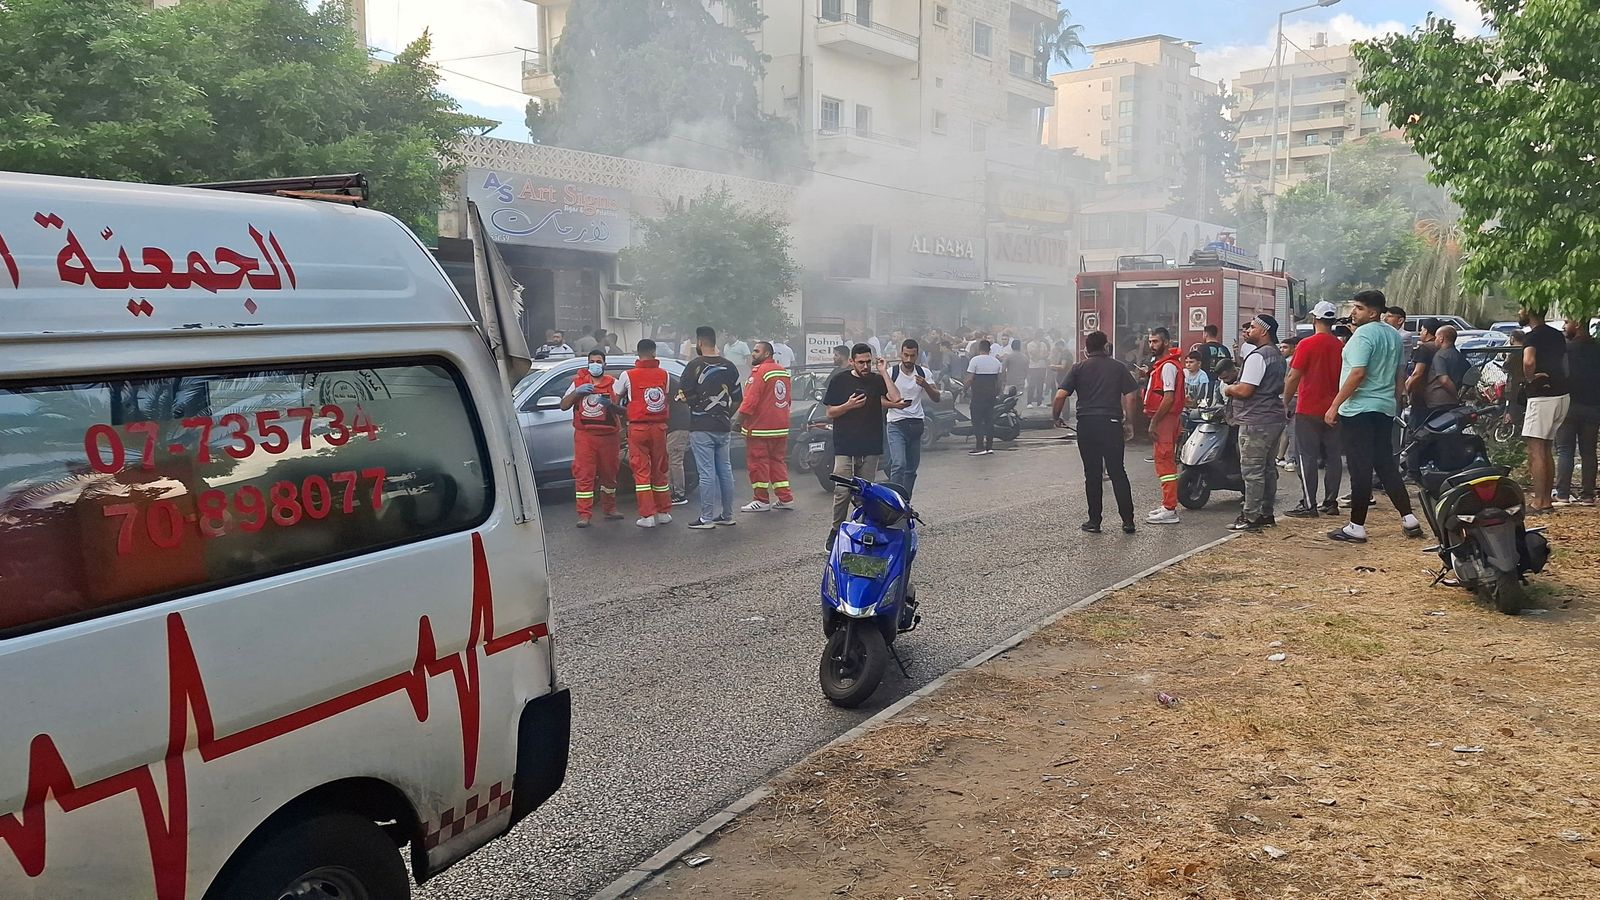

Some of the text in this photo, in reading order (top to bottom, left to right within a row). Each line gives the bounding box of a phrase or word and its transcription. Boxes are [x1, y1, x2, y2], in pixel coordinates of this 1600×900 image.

[518, 177, 557, 203] Art
[910, 234, 975, 259] AL BABA
[1185, 276, 1215, 287] الدفاع
[1185, 289, 1215, 300] المدني
[84, 404, 379, 475] 07-735734
[103, 466, 387, 557] 70-898077
